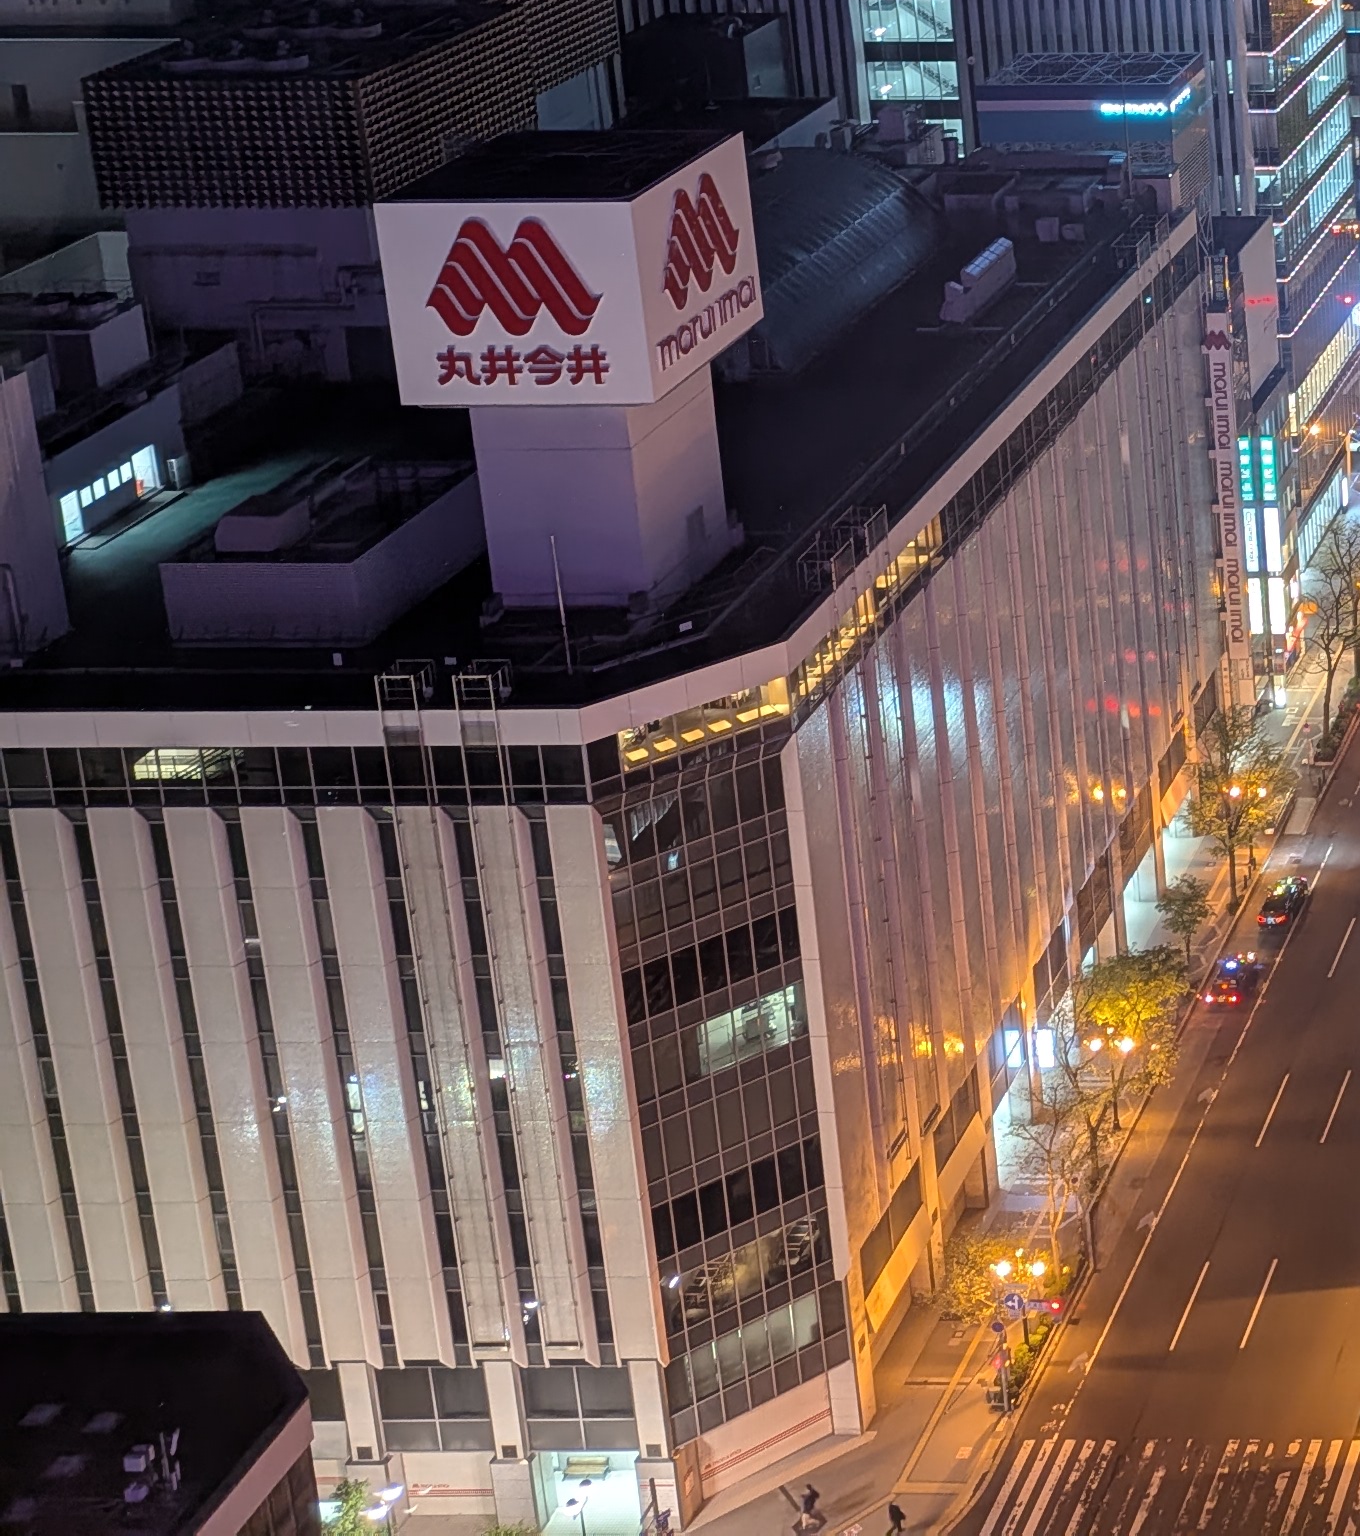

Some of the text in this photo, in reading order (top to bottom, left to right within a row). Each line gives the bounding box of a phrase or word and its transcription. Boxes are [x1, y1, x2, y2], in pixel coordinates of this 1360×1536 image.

[436, 344, 610, 386] 丸井今井
[1213, 362, 1231, 450] marui imai
[1220, 461, 1238, 547] marui imai
[1226, 559, 1241, 606] marui
[1230, 610, 1244, 643] imai
